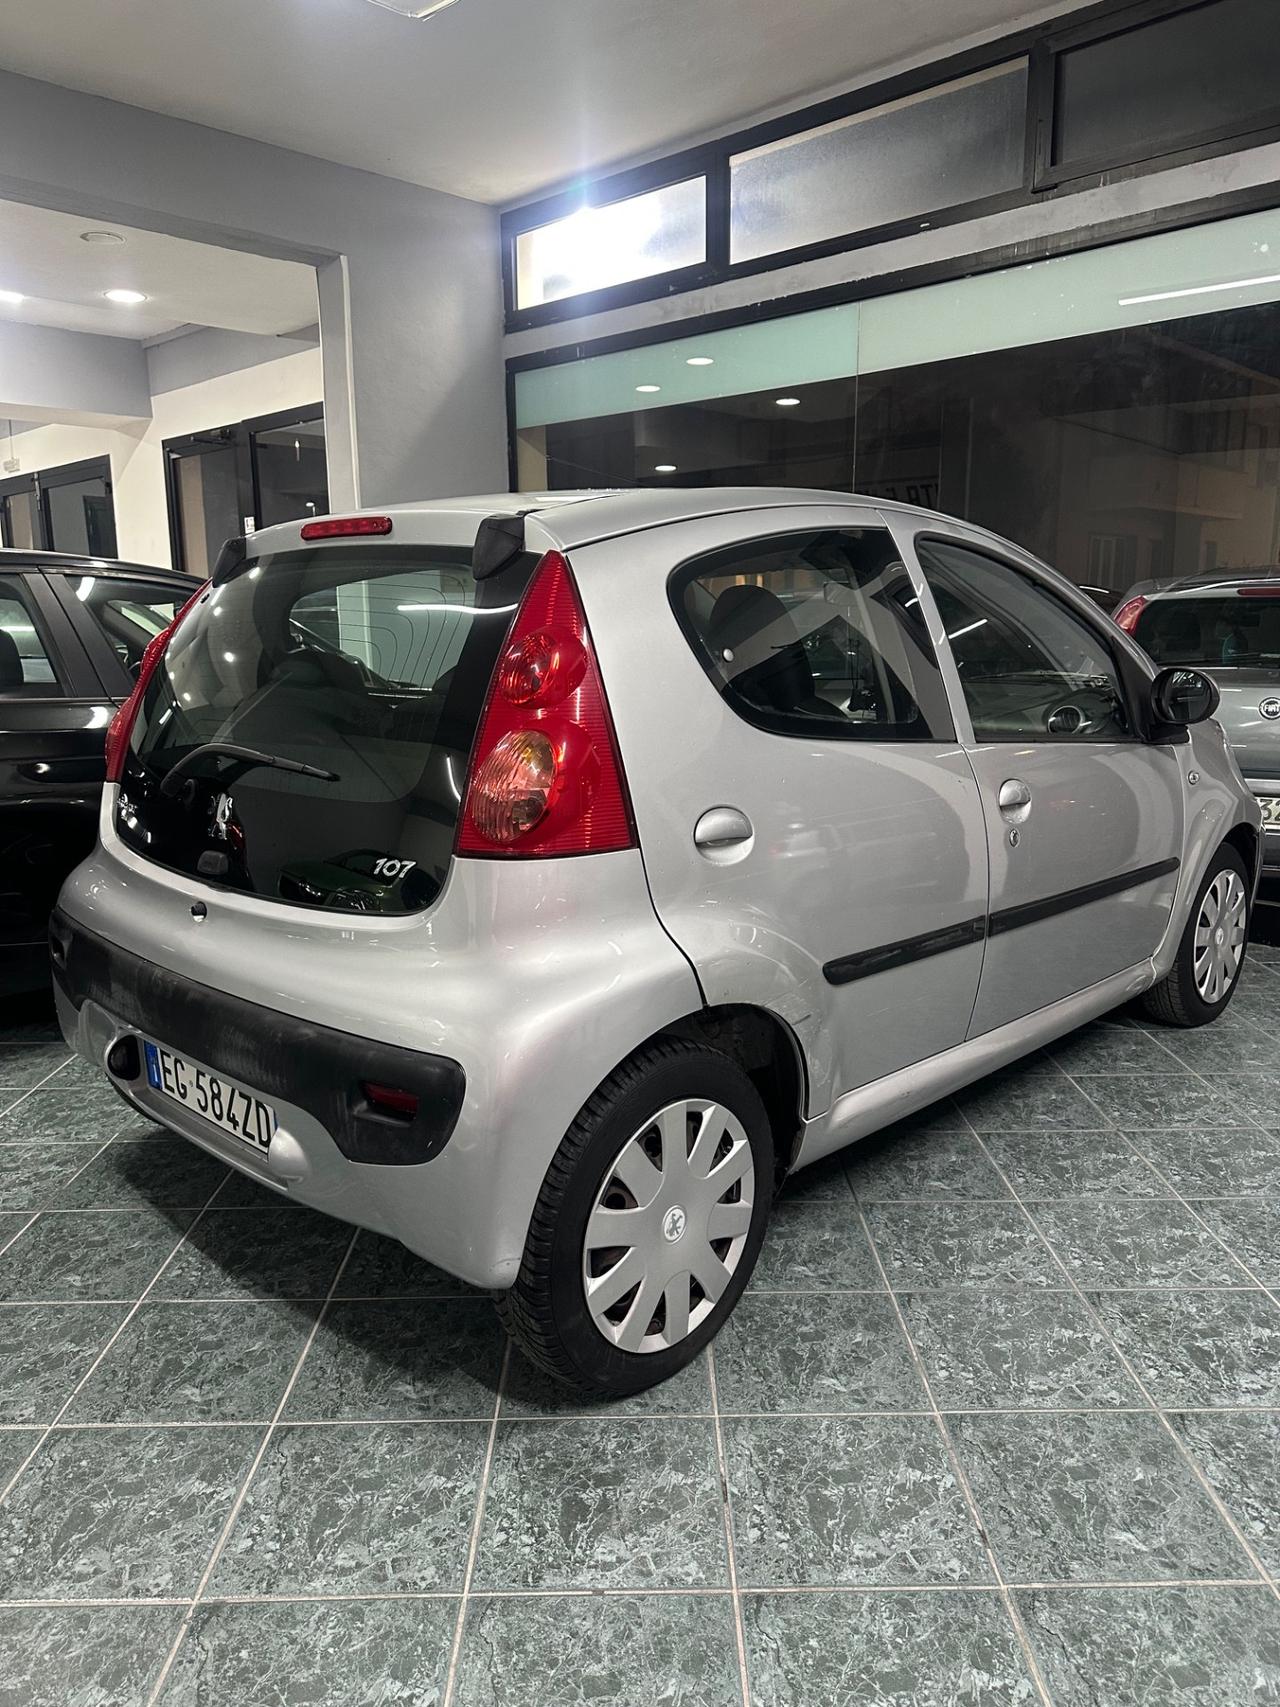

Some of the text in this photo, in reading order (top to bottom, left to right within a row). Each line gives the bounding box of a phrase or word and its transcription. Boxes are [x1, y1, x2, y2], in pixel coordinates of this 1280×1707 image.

[373, 858, 417, 879] 107
[160, 1049, 272, 1148] EG 584ZD
